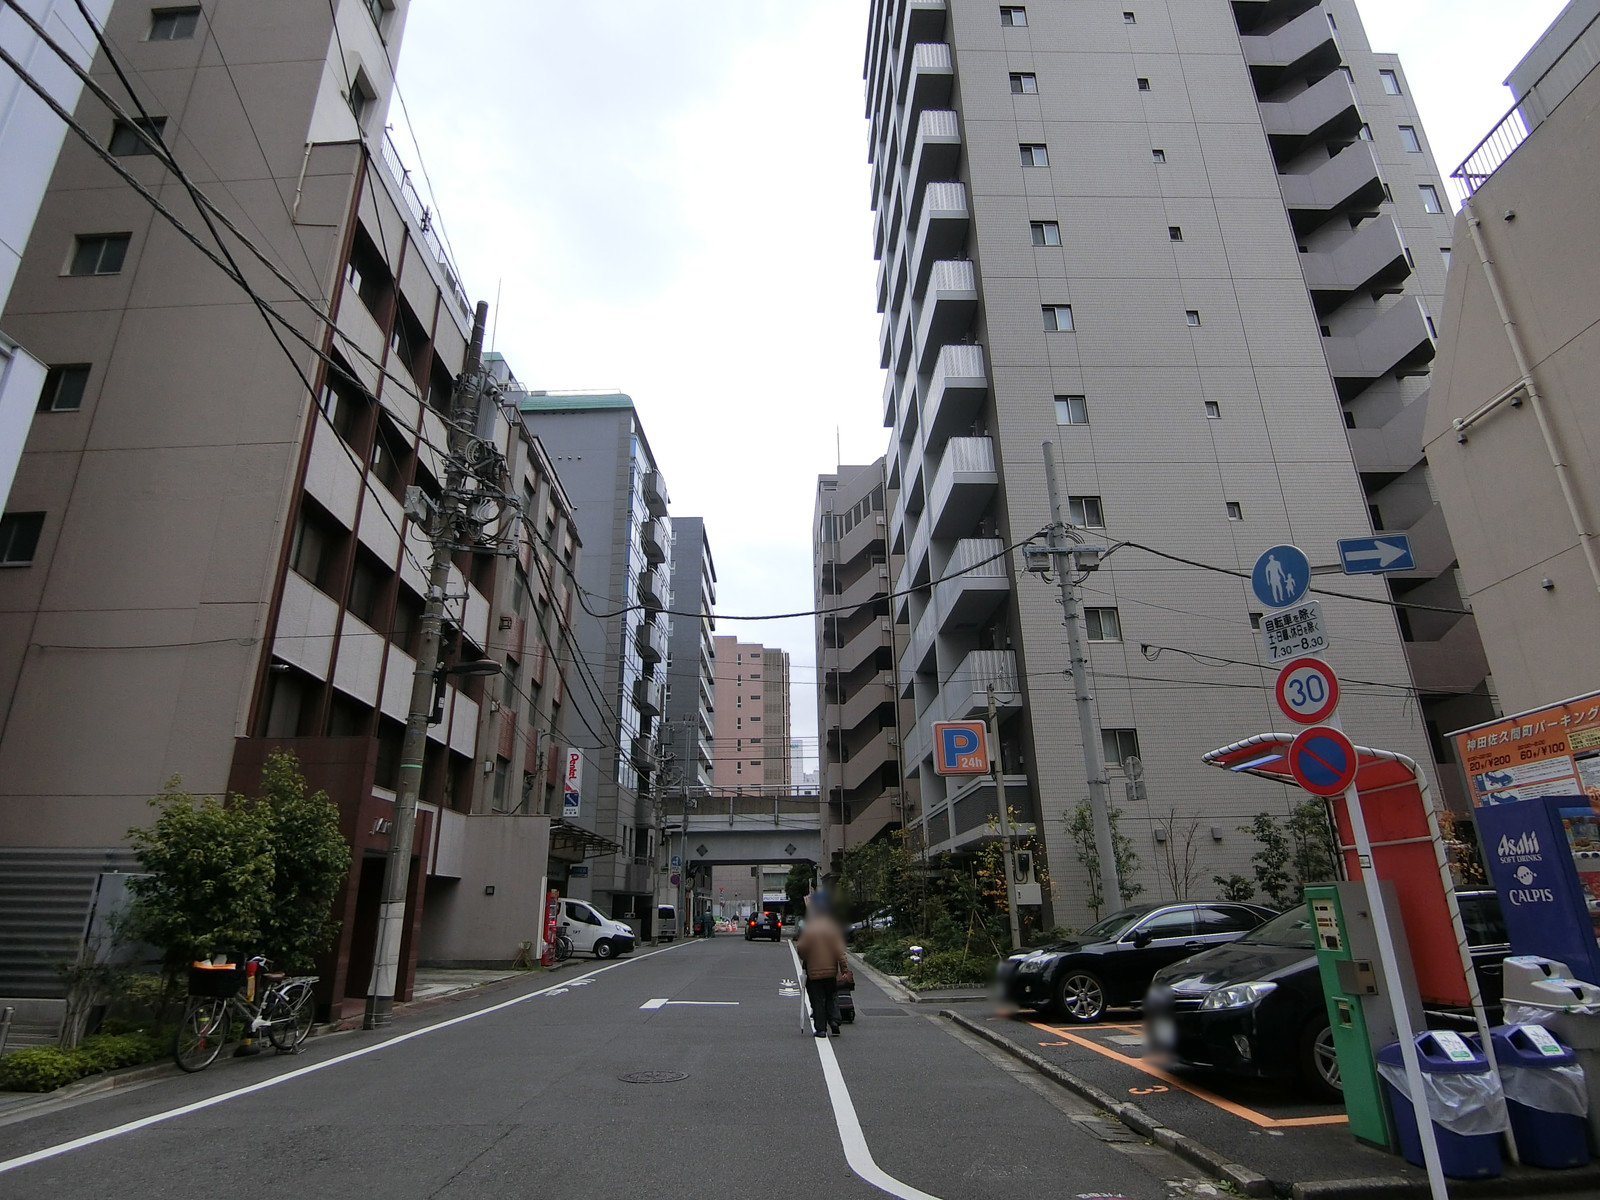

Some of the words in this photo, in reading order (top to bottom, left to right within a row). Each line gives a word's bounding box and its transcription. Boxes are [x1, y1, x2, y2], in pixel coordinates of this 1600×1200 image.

[1265, 608, 1317, 631] 自転車を除く
[1289, 675, 1325, 706] 30
[942, 728, 979, 768] P
[961, 757, 983, 768] 24h
[1497, 830, 1540, 857] Asahi
[1500, 855, 1516, 864] SOFT
[1516, 853, 1543, 863] DRINKS
[1509, 888, 1554, 906] CALPIS
